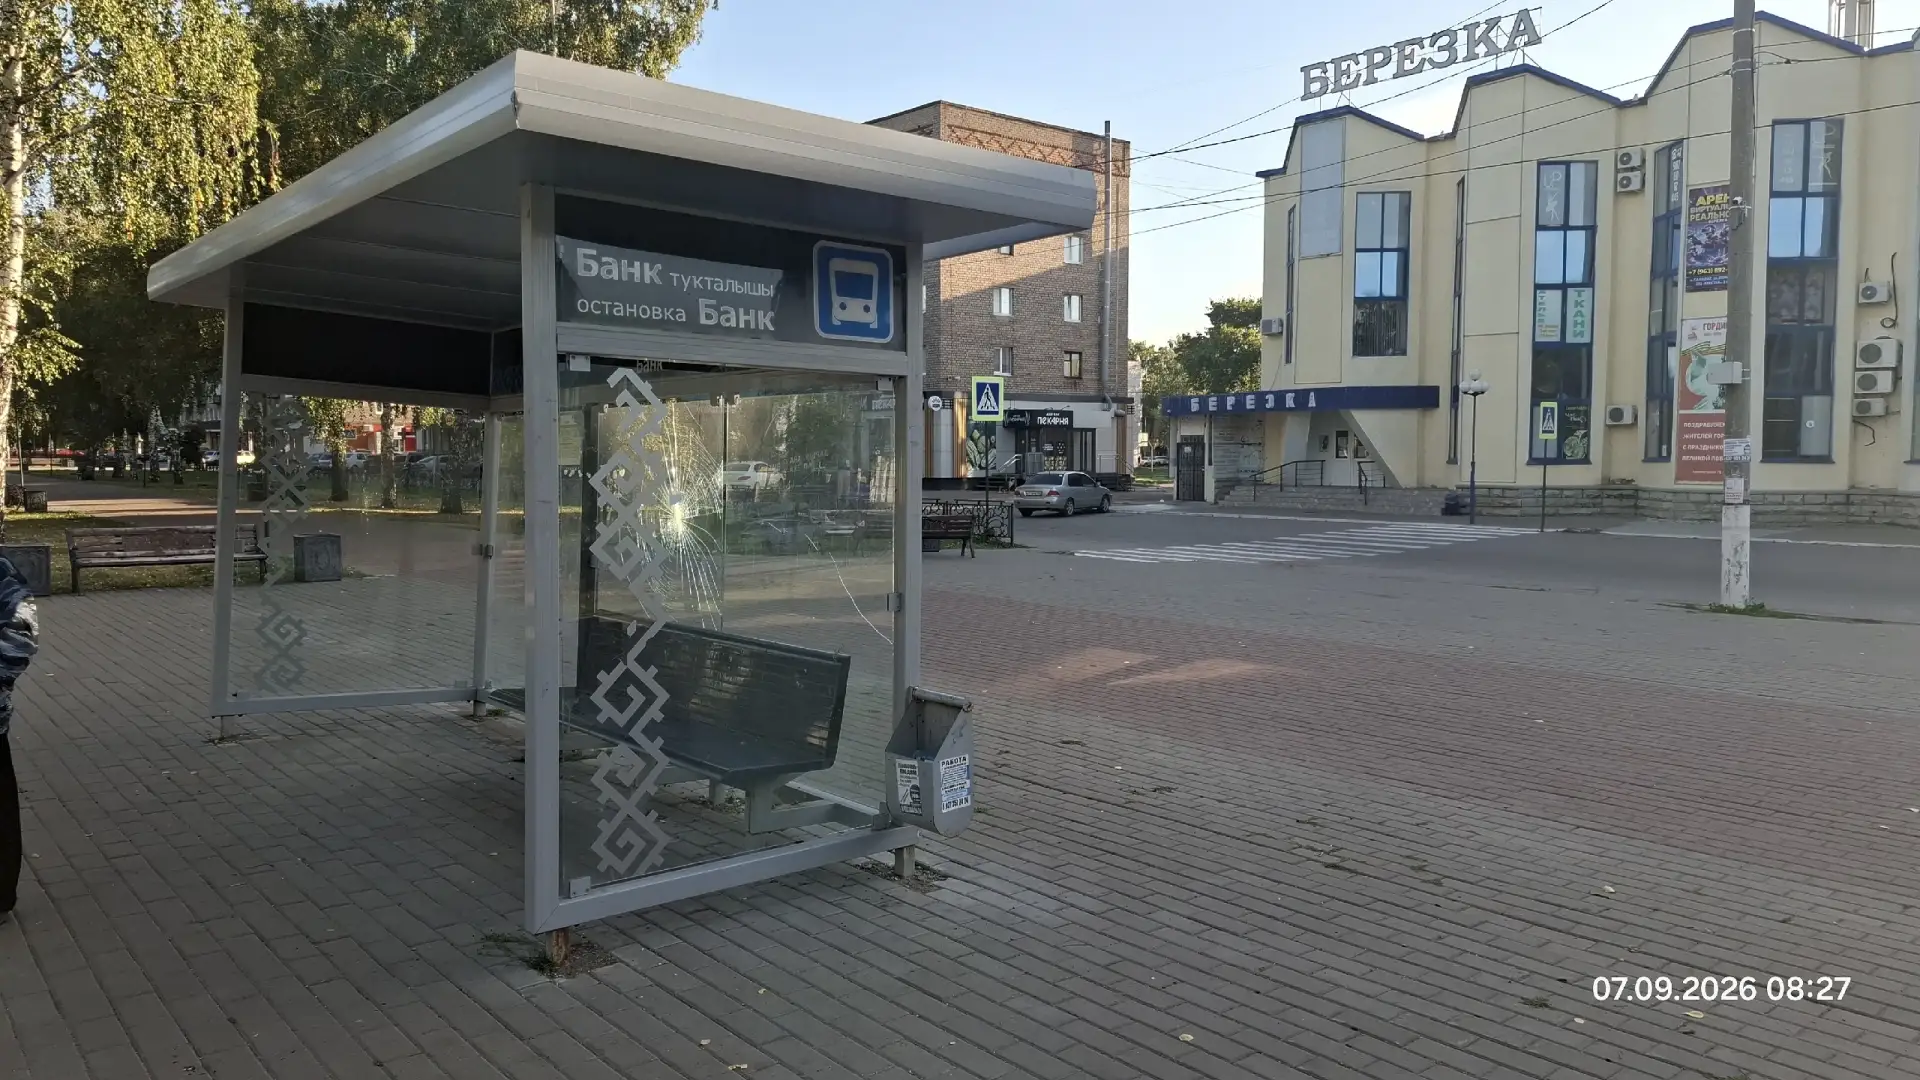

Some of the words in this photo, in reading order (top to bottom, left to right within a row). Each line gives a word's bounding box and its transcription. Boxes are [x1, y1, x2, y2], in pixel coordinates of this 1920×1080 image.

[1300, 8, 1542, 101] БЕРЕЗКА
[576, 247, 663, 285] Банк
[577, 297, 687, 322] остановка
[699, 298, 775, 331] Банк
[1573, 289, 1586, 339] ТКАНИ
[1190, 391, 1317, 413] БЕРЕЗКА
